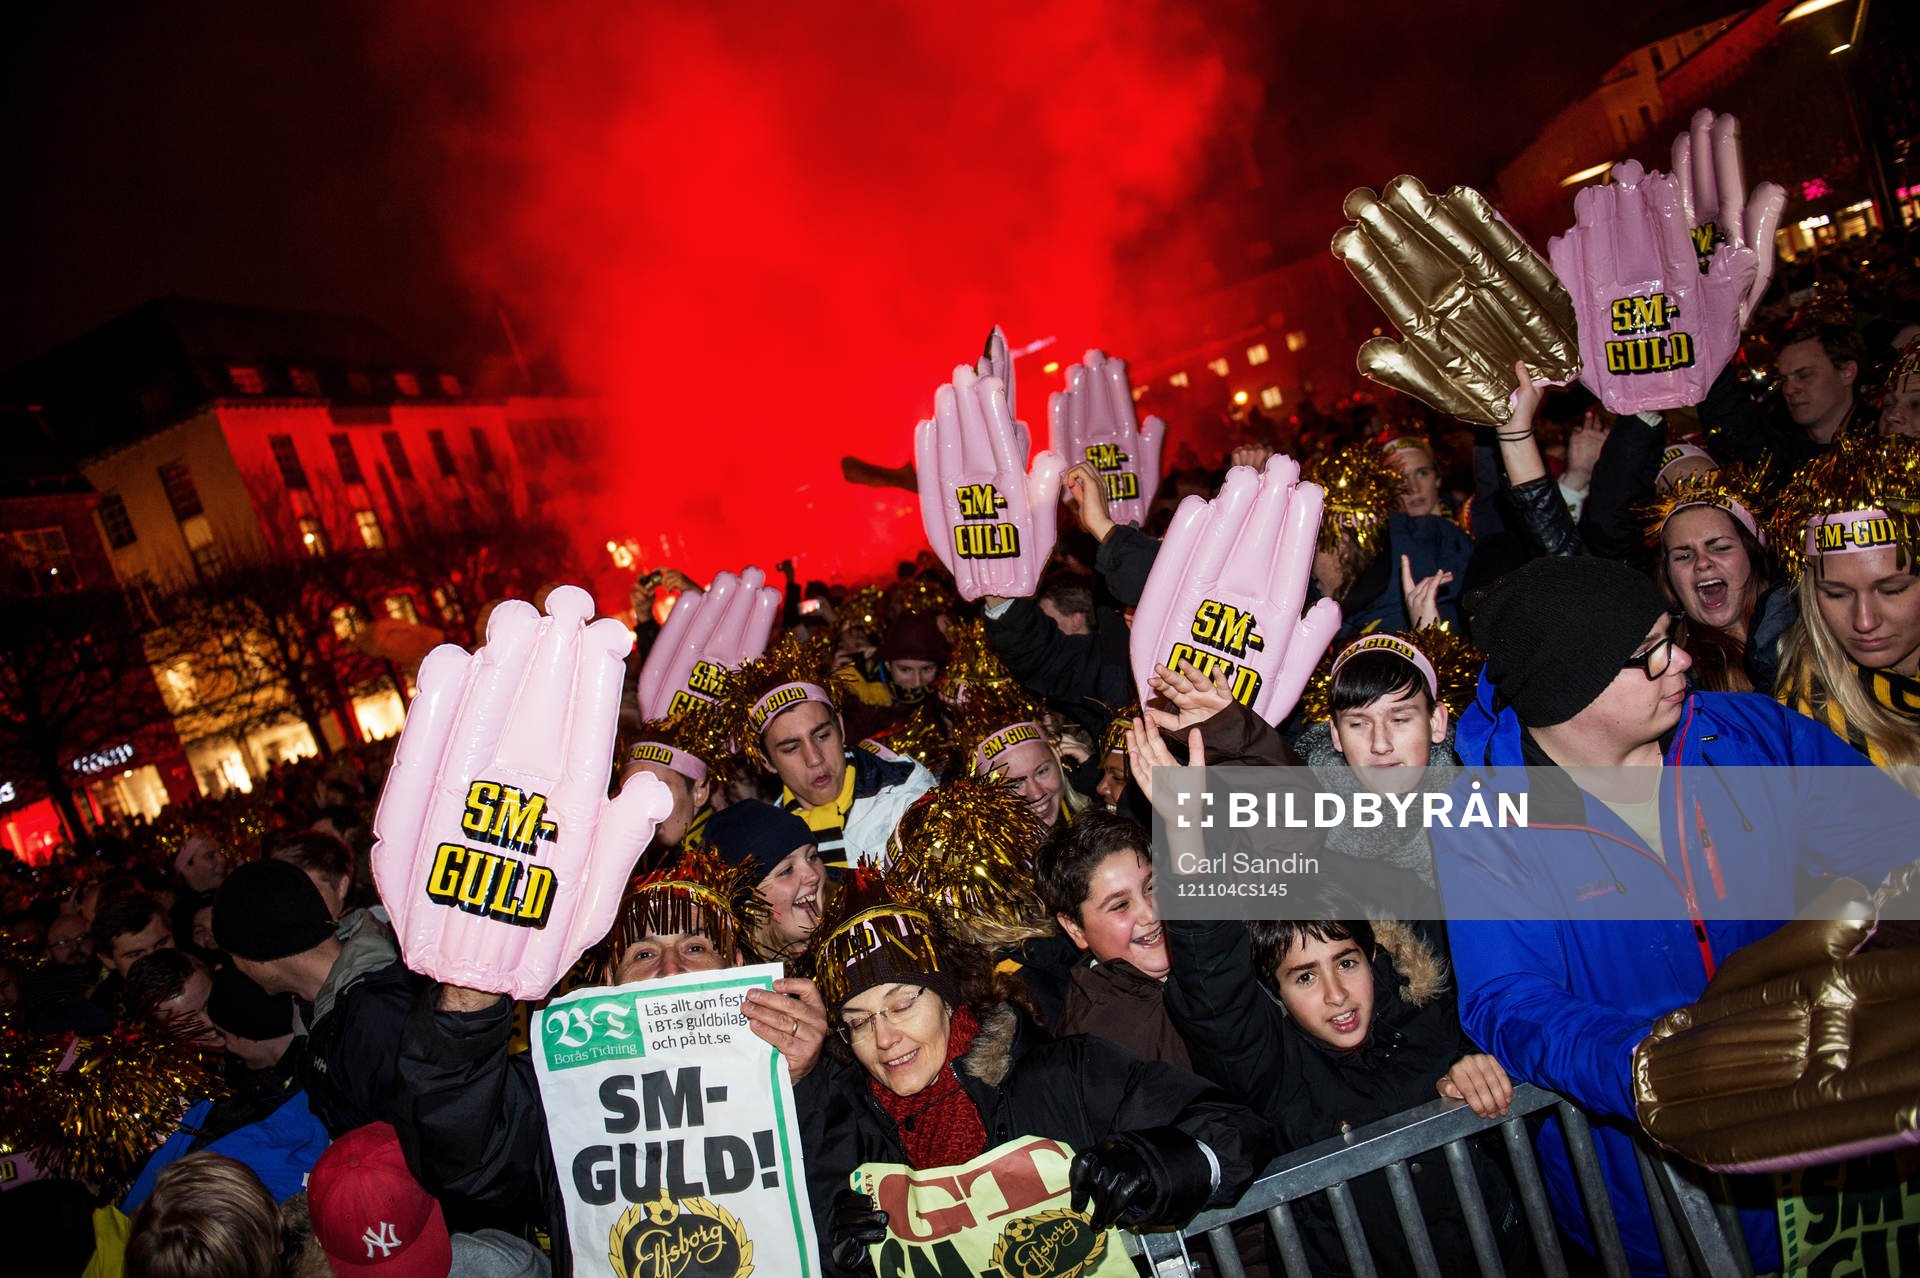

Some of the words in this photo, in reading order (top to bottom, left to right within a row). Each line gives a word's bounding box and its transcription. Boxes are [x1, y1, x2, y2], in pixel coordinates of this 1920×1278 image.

[1612, 293, 1680, 335] SM-
[1605, 332, 1695, 375] GULD
[956, 484, 1008, 520] SM-
[1191, 599, 1265, 660] SM-
[754, 687, 808, 728] M-GULD
[982, 726, 1042, 760] SM-GULD
[461, 780, 559, 856] SM-
[426, 842, 558, 930] GULD
[546, 1003, 634, 1048] BT
[645, 1002, 668, 1017] Läs
[671, 998, 693, 1013] allt
[694, 999, 717, 1011] om
[648, 1022, 653, 1033] i
[655, 1019, 684, 1032] BT:s
[686, 1013, 750, 1030] guldbilag
[554, 1050, 589, 1065] Borås
[589, 1043, 637, 1058] Tidning
[652, 1035, 677, 1050] och
[680, 1032, 696, 1049] på
[699, 1033, 731, 1045] bt.se
[599, 1066, 728, 1133] SM-
[572, 1129, 779, 1206] GULD!
[878, 1139, 1072, 1242] GT
[634, 1225, 727, 1278] Elfsborg
[1015, 1218, 1079, 1278] Elfsborg
